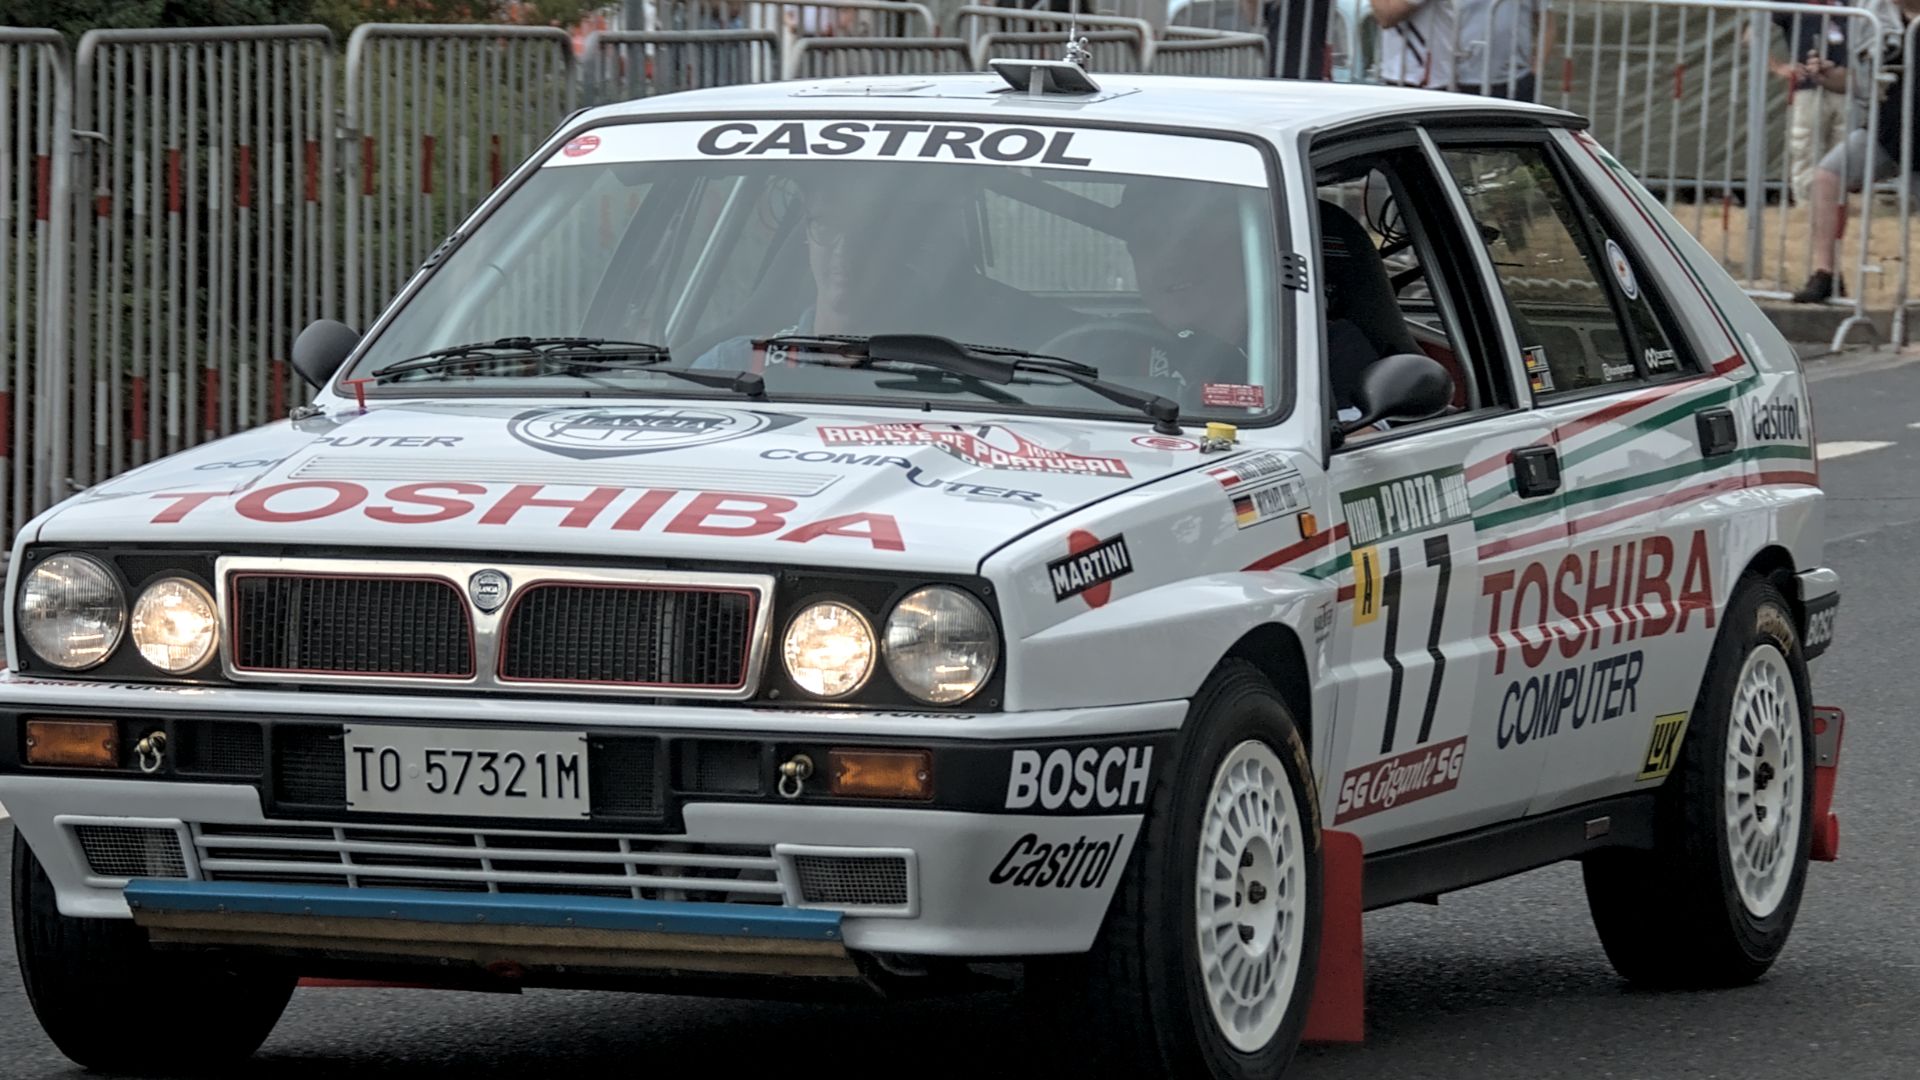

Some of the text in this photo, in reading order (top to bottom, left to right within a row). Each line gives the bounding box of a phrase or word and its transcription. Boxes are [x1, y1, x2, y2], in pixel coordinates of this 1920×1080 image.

[697, 122, 1092, 167] CASTROL
[582, 416, 709, 430] LANCIA
[1752, 395, 1802, 440] Castrol
[759, 448, 1043, 502] COMPUTER
[823, 427, 1126, 474] RALLYE DE PORTUGAL
[149, 480, 906, 552] TOSHIBA
[1379, 474, 1442, 537] PORTO
[1051, 541, 1129, 596] MARTINI
[1361, 552, 1373, 616] A
[1481, 529, 1717, 676] TOSHIBA
[1381, 533, 1453, 756] 17
[1496, 650, 1645, 750] COMPUTER
[353, 746, 580, 800] TO 57321M
[1004, 745, 1154, 810] BOSCH
[1336, 743, 1465, 815] SG Gigante SG
[988, 832, 1125, 888] Castrol
